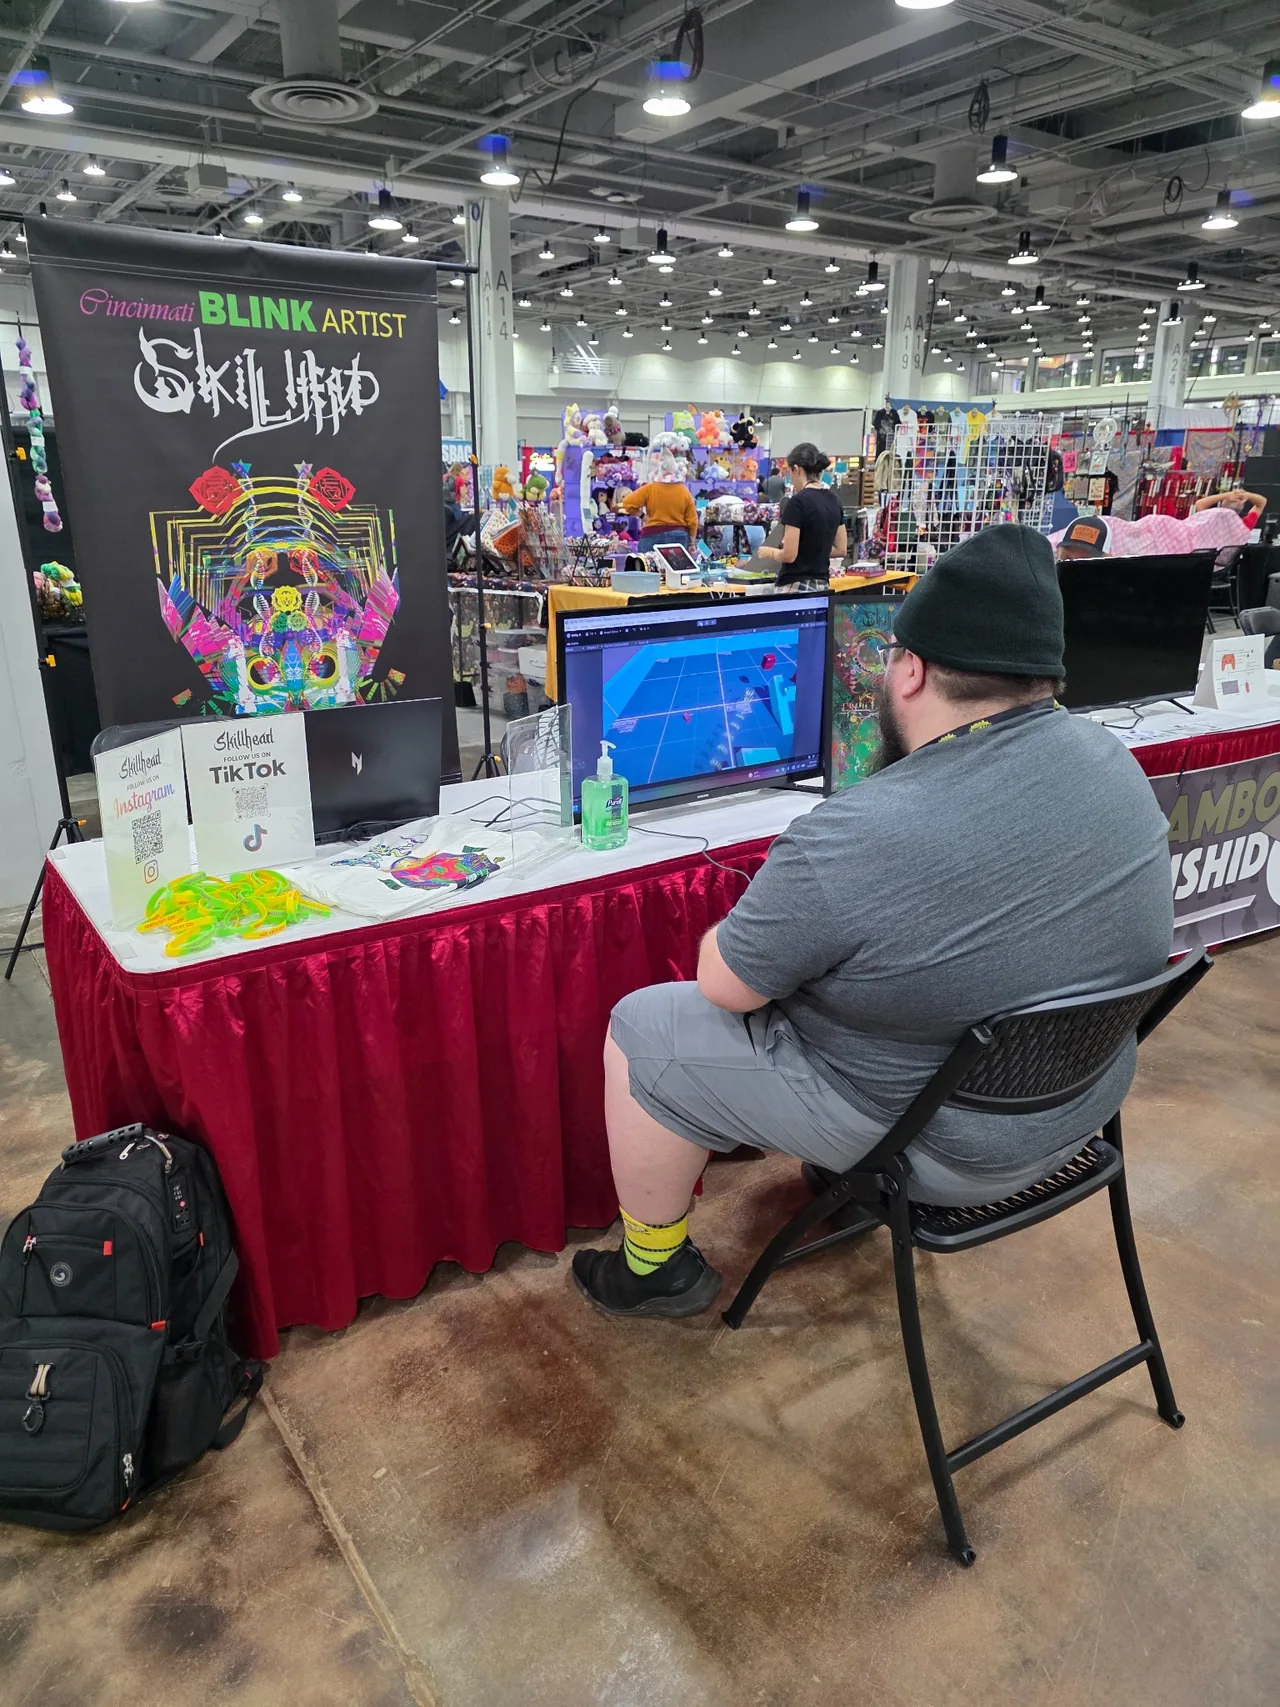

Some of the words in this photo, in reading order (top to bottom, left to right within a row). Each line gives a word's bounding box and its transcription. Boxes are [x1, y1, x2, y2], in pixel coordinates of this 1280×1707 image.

[79, 288, 195, 323] Cincinnati
[198, 290, 318, 333] BLINK
[321, 308, 407, 338] ARTIST
[213, 727, 275, 752] Skillhead
[119, 747, 162, 780] Skillhead
[209, 759, 287, 784] TikTok
[223, 754, 250, 762] FOLLOW
[126, 780, 146, 791] FOLLOW
[113, 783, 175, 820] Instagram
[1168, 771, 1280, 845] AMBO
